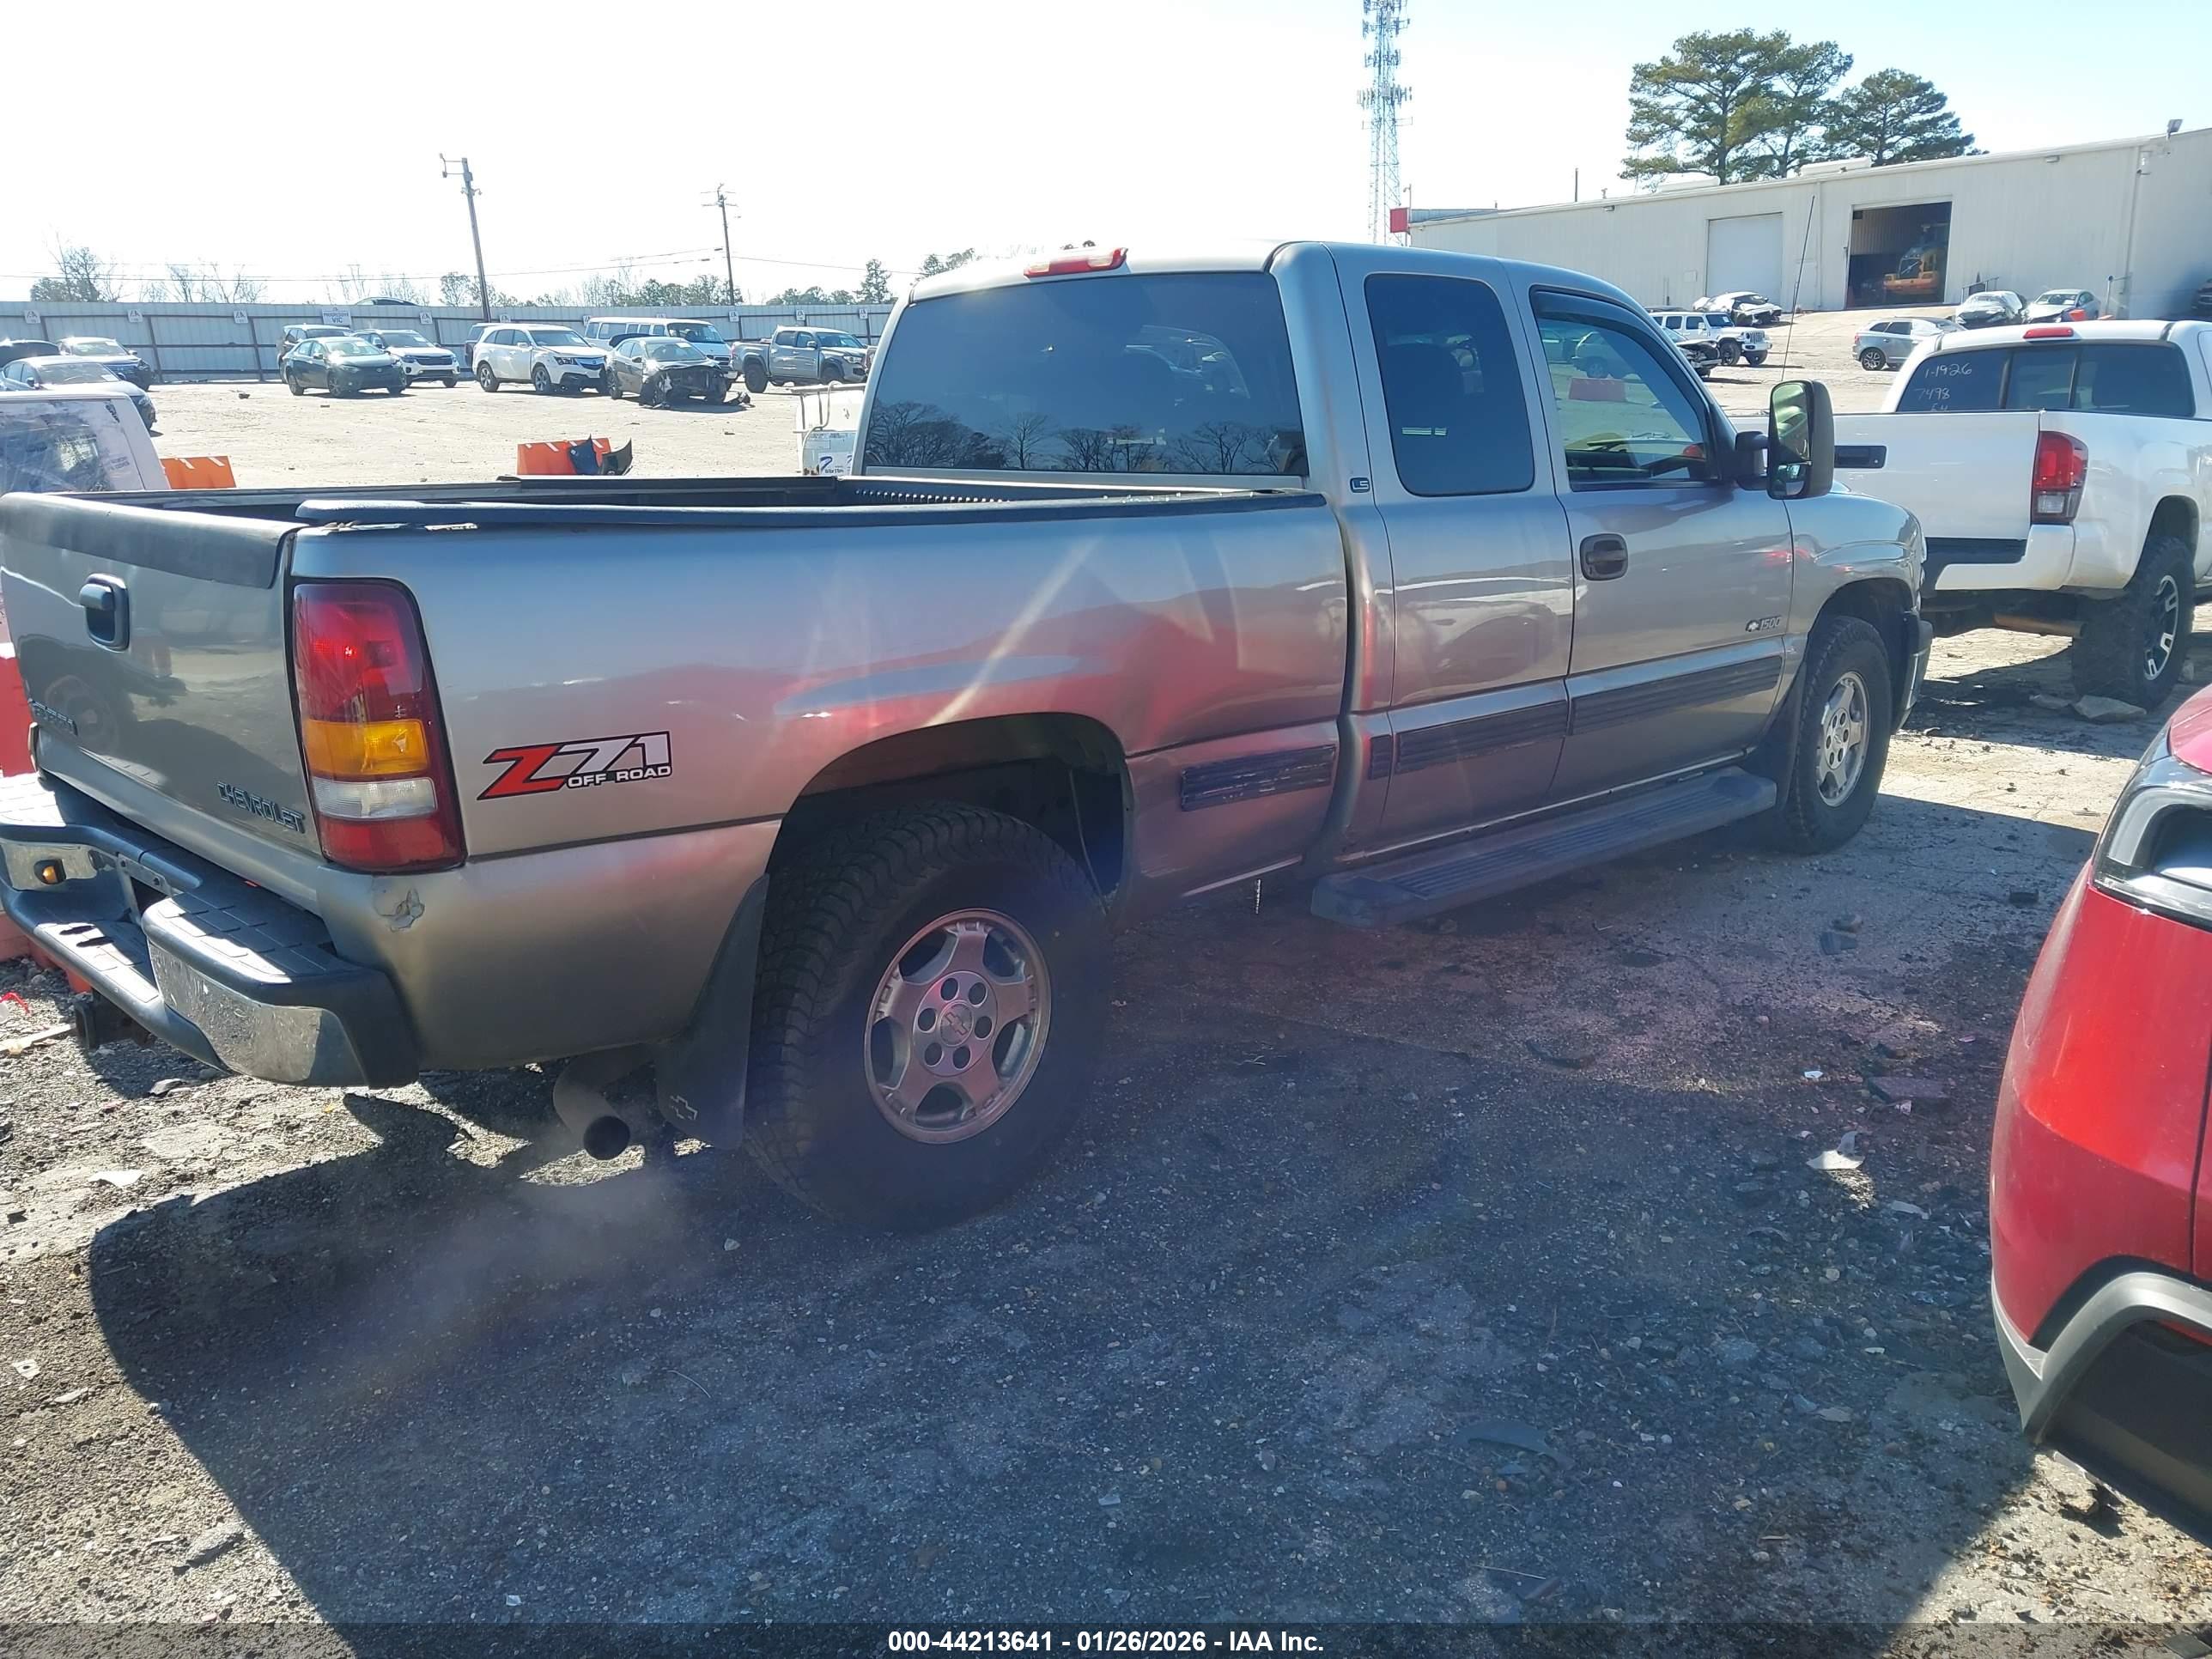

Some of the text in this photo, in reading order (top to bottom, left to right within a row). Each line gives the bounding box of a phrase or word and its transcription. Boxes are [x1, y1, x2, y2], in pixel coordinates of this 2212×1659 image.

[1914, 386, 1951, 401] 7498
[1352, 479, 1370, 490] LS
[1759, 615, 1784, 632] 1500
[477, 731, 672, 800] Z71
[567, 764, 672, 789] OFF ROAD
[216, 781, 305, 834] CHEVROLET
